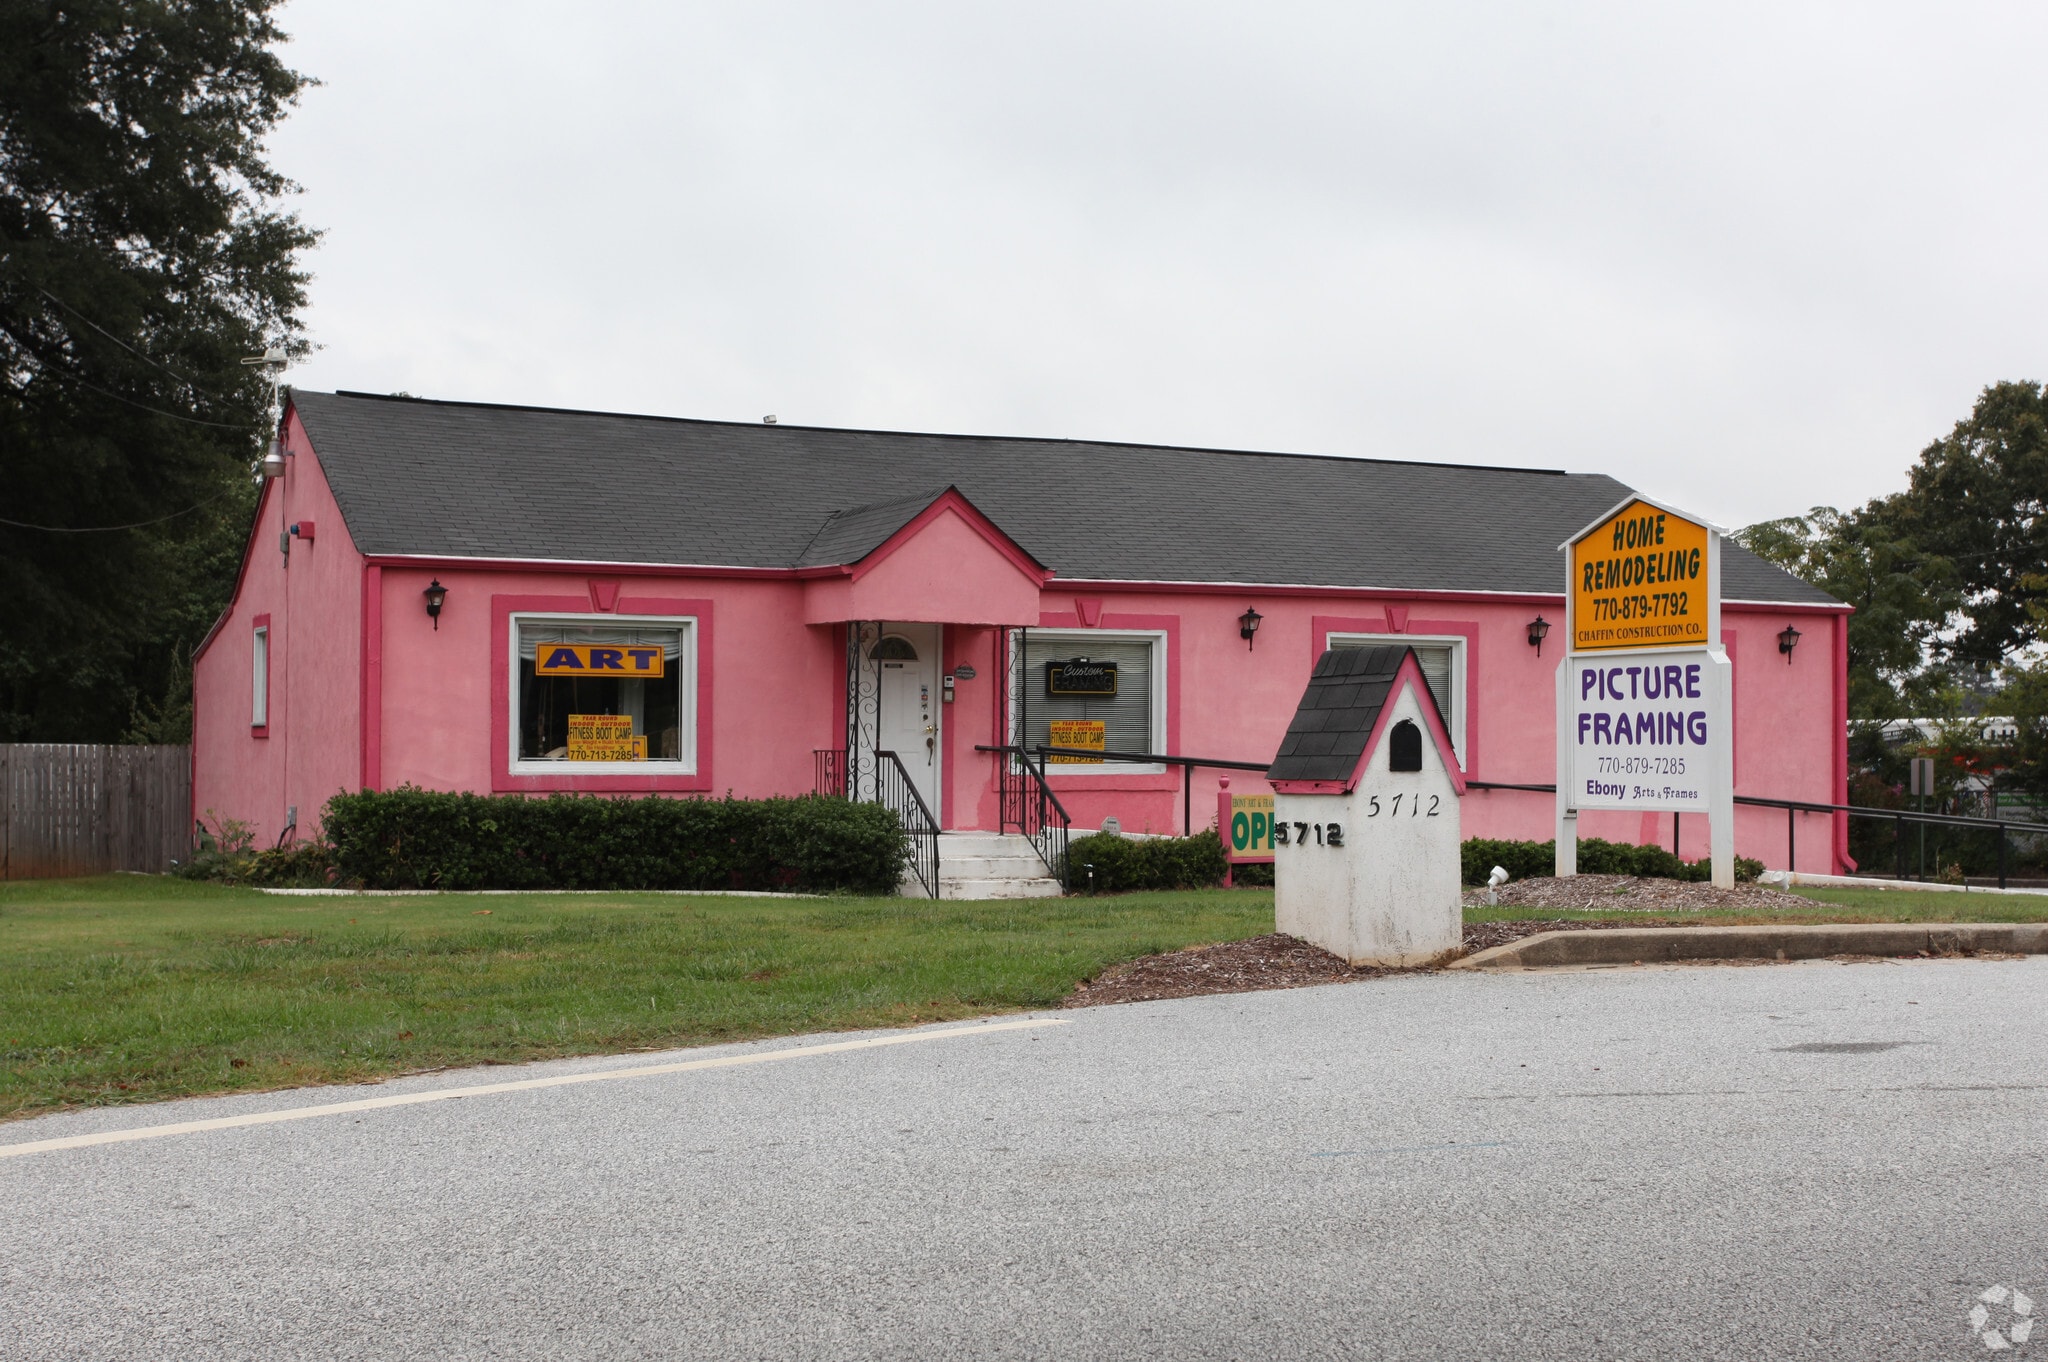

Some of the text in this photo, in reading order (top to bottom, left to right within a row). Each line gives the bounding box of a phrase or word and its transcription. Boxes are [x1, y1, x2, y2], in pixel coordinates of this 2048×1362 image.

[1613, 514, 1666, 551] HOME
[1583, 547, 1700, 593] REMODELING
[1593, 591, 1688, 621] 770-879-7792
[1578, 623, 1702, 641] CHAFFIN CONSTRUCTION CO.
[543, 648, 658, 670] ART
[1063, 664, 1104, 676] Custom
[1582, 664, 1701, 701] PICTURE
[569, 727, 631, 740] FITNESS BOOT CAMP
[1051, 731, 1104, 743] FITNESS BOOT CAMP
[1578, 711, 1707, 745] FRAMING
[570, 750, 632, 760] 770-713-7285
[1598, 757, 1686, 775] 770-879-7285
[1586, 779, 1626, 800] Ebony
[1633, 786, 1655, 799] Arts
[1663, 786, 1698, 800] Frames
[1368, 793, 1440, 818] 5712
[1275, 821, 1344, 846] 5712
